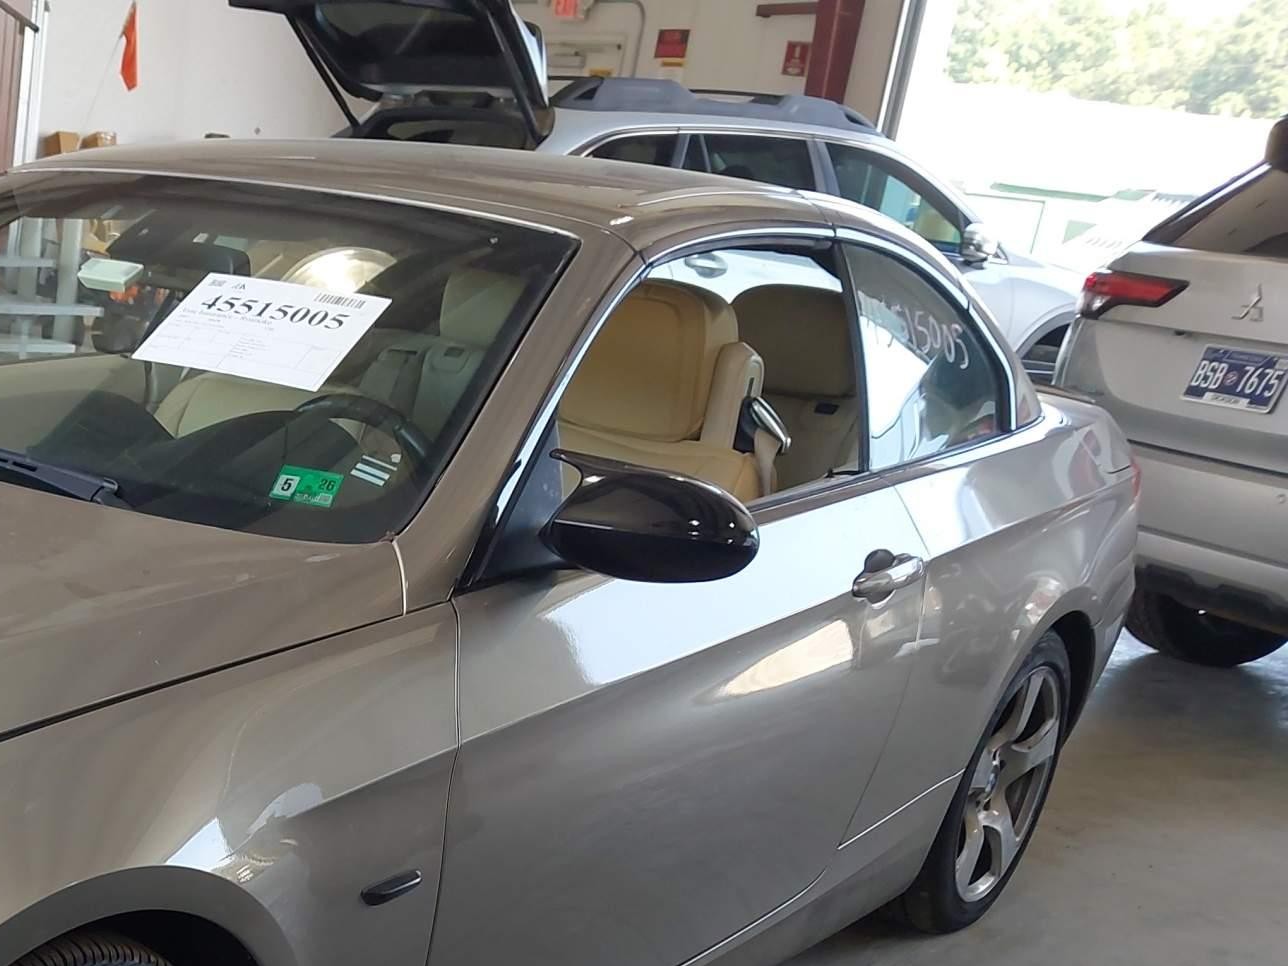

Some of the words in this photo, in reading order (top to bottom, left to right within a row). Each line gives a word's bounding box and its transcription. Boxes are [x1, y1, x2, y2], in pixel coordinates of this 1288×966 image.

[201, 294, 352, 331] 45515005
[1190, 360, 1229, 389] BSB
[1236, 366, 1284, 397] 7675
[280, 478, 293, 492] 5
[318, 479, 337, 492] 26
